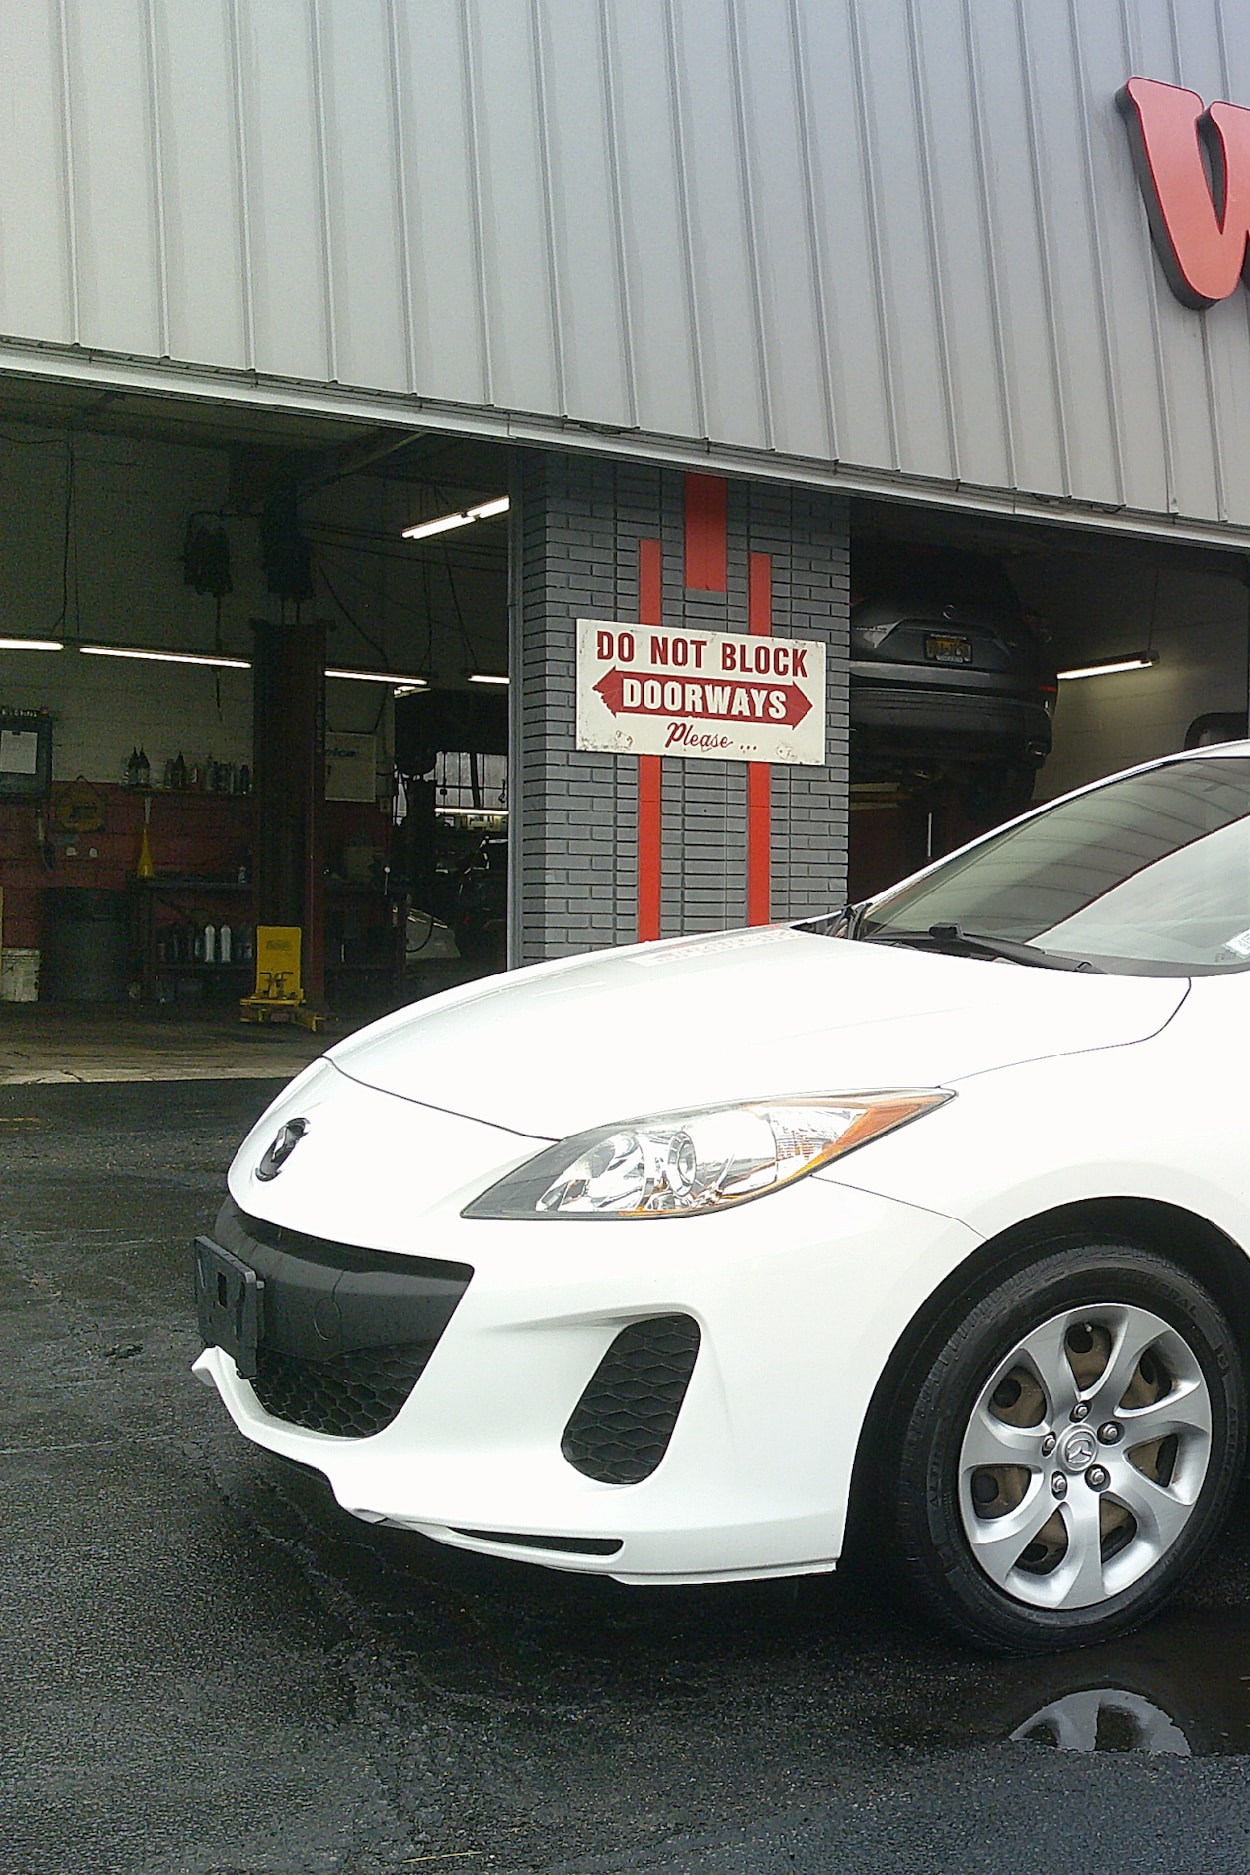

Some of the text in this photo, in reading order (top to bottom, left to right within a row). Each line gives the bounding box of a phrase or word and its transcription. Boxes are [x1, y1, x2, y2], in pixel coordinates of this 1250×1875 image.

[597, 630, 808, 678] DO NOT BLOCK
[622, 677, 787, 720] DOORWAYS
[664, 721, 734, 752] Please
